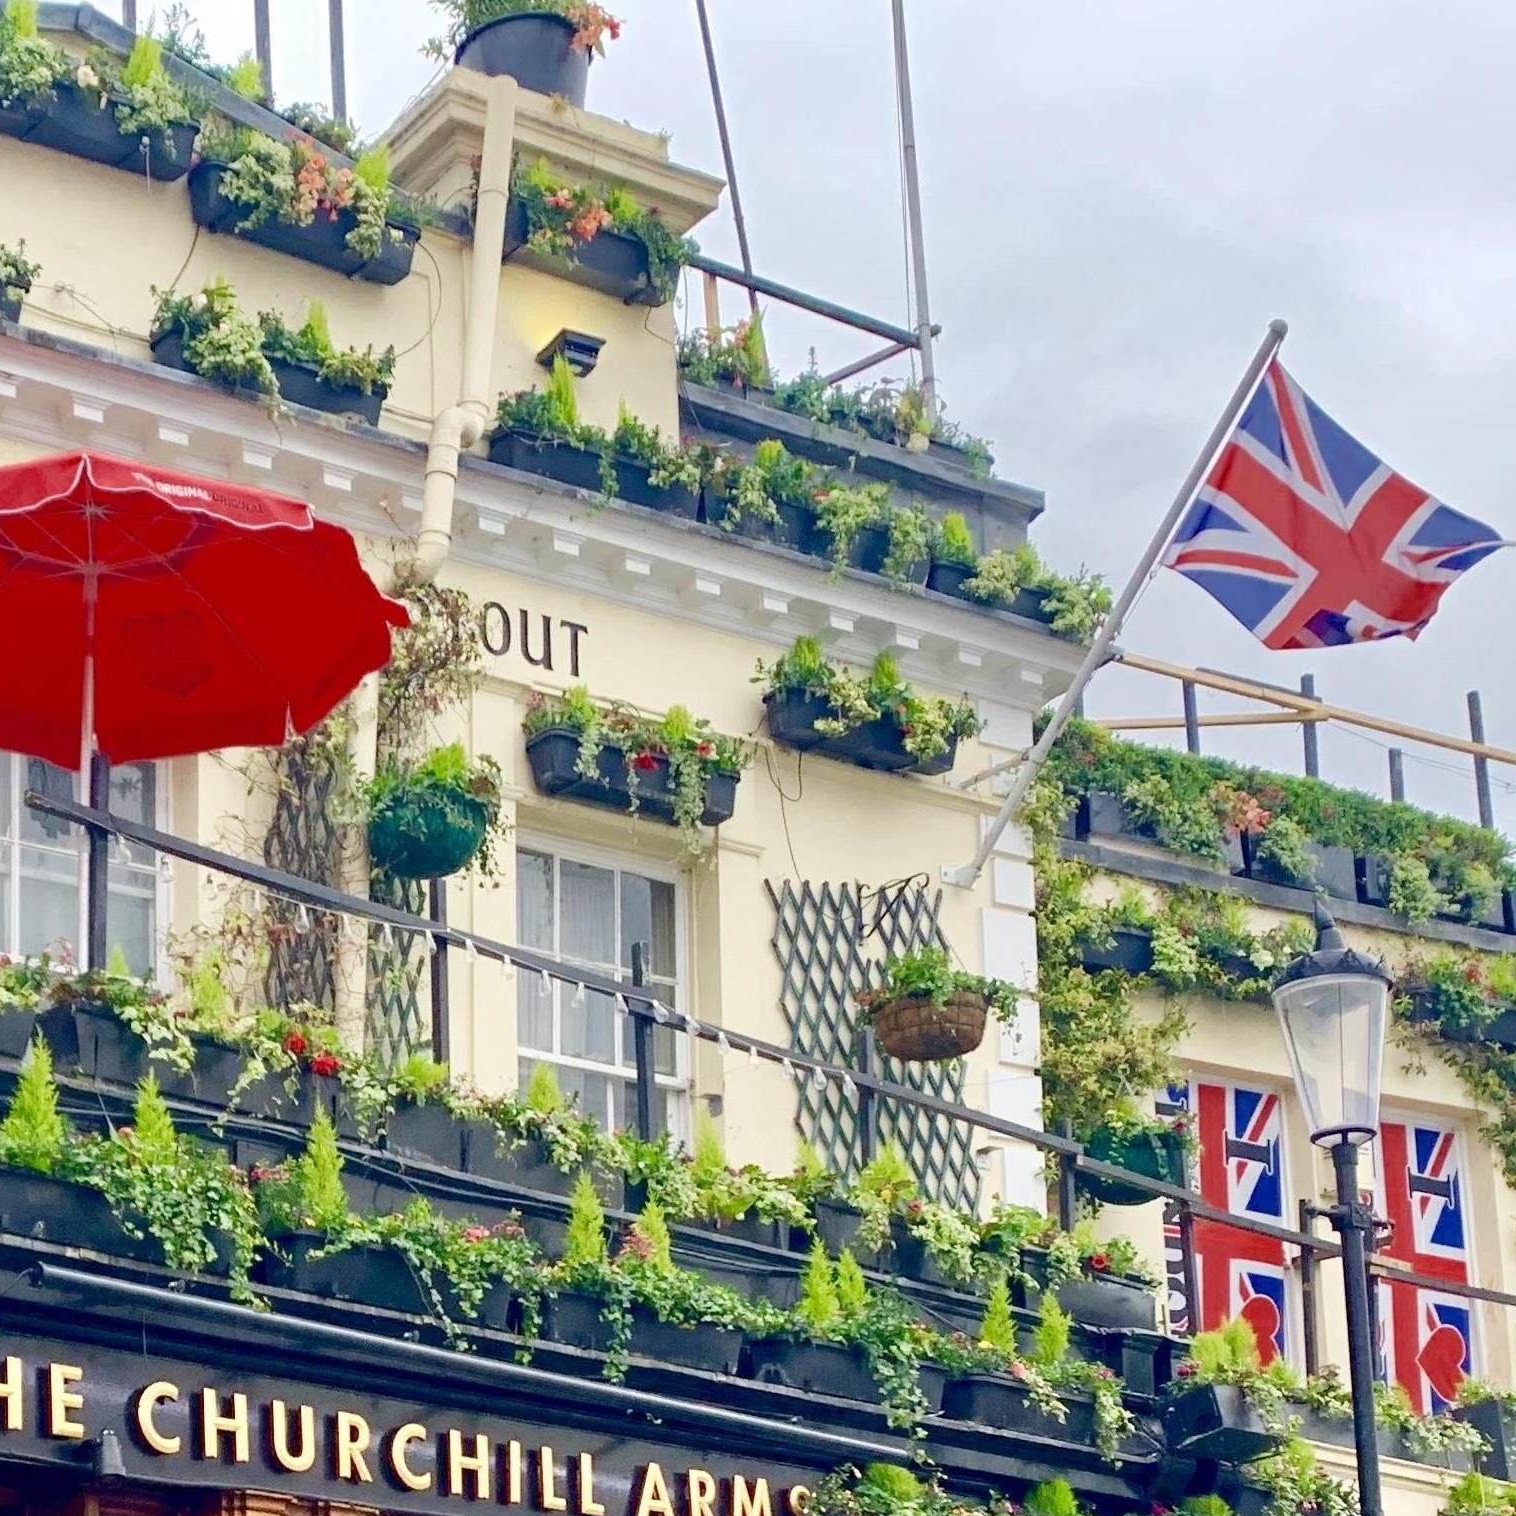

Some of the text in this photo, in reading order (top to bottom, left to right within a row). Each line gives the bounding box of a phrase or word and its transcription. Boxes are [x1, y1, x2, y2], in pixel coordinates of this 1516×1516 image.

[155, 482, 212, 501] ORIGINAL
[482, 601, 588, 677] OUT
[136, 1381, 605, 1516] CHURCHILL
